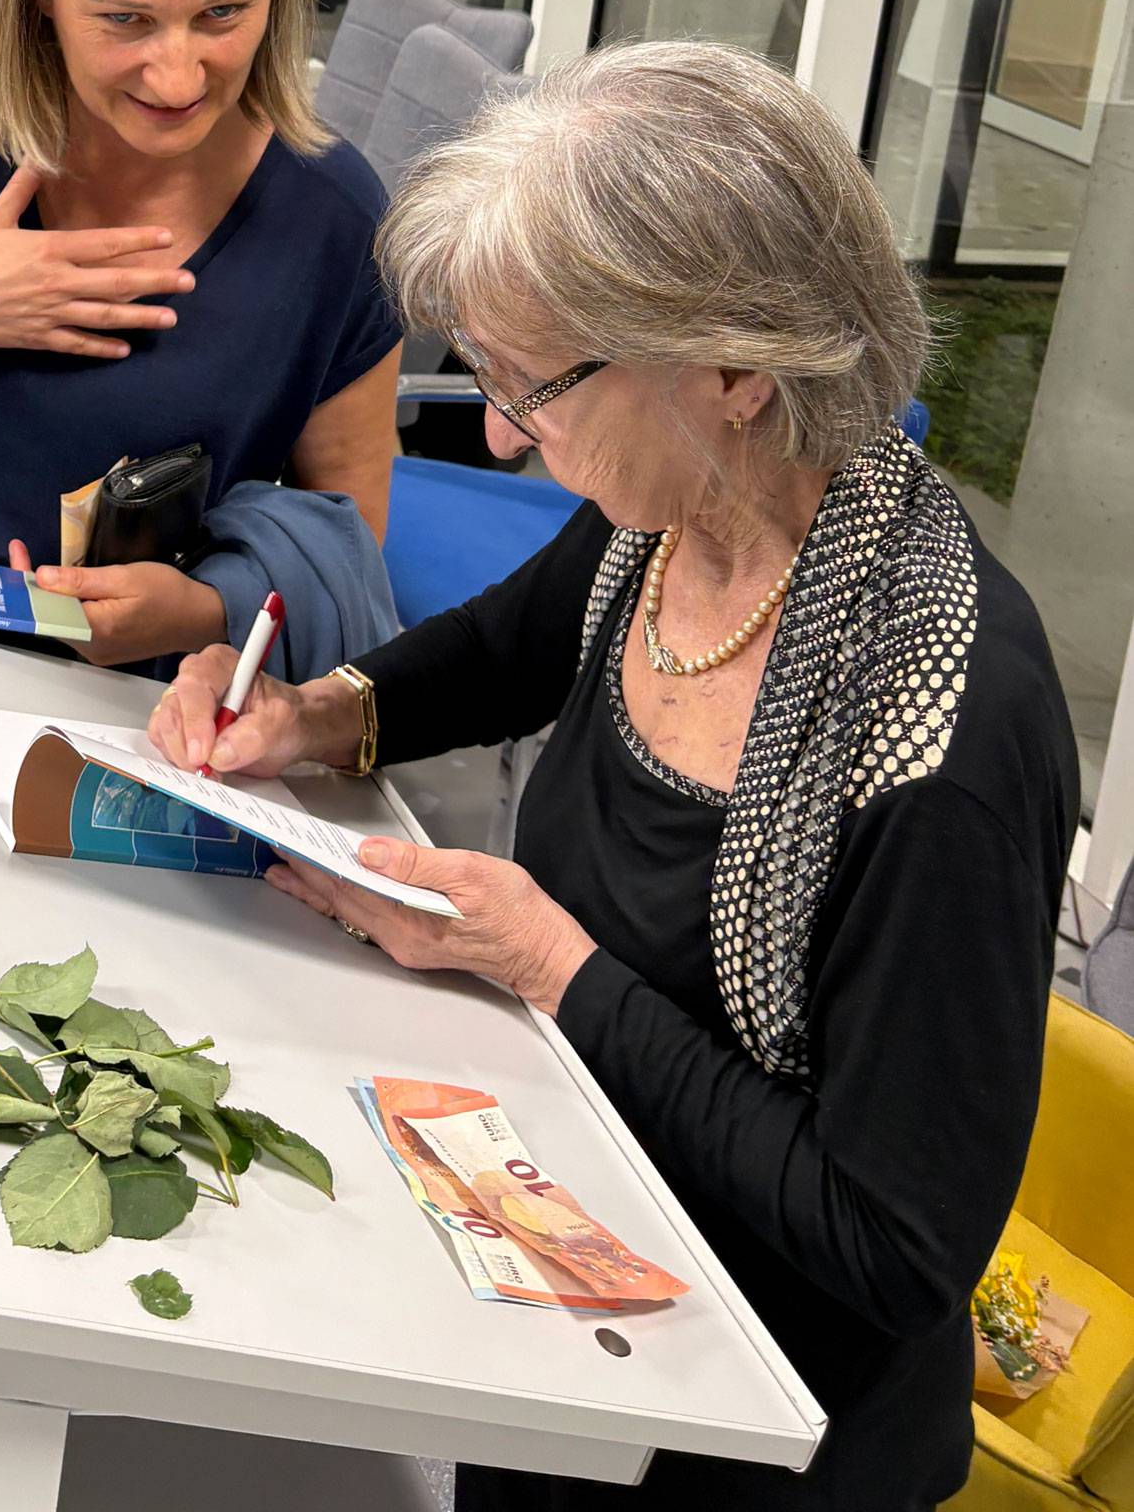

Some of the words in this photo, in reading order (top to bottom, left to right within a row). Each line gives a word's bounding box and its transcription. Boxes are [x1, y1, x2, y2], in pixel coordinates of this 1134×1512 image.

[478, 1114, 499, 1142] EURO
[505, 1159, 555, 1197] 10
[451, 1208, 503, 1238] 10
[504, 1254, 524, 1285] EURO
